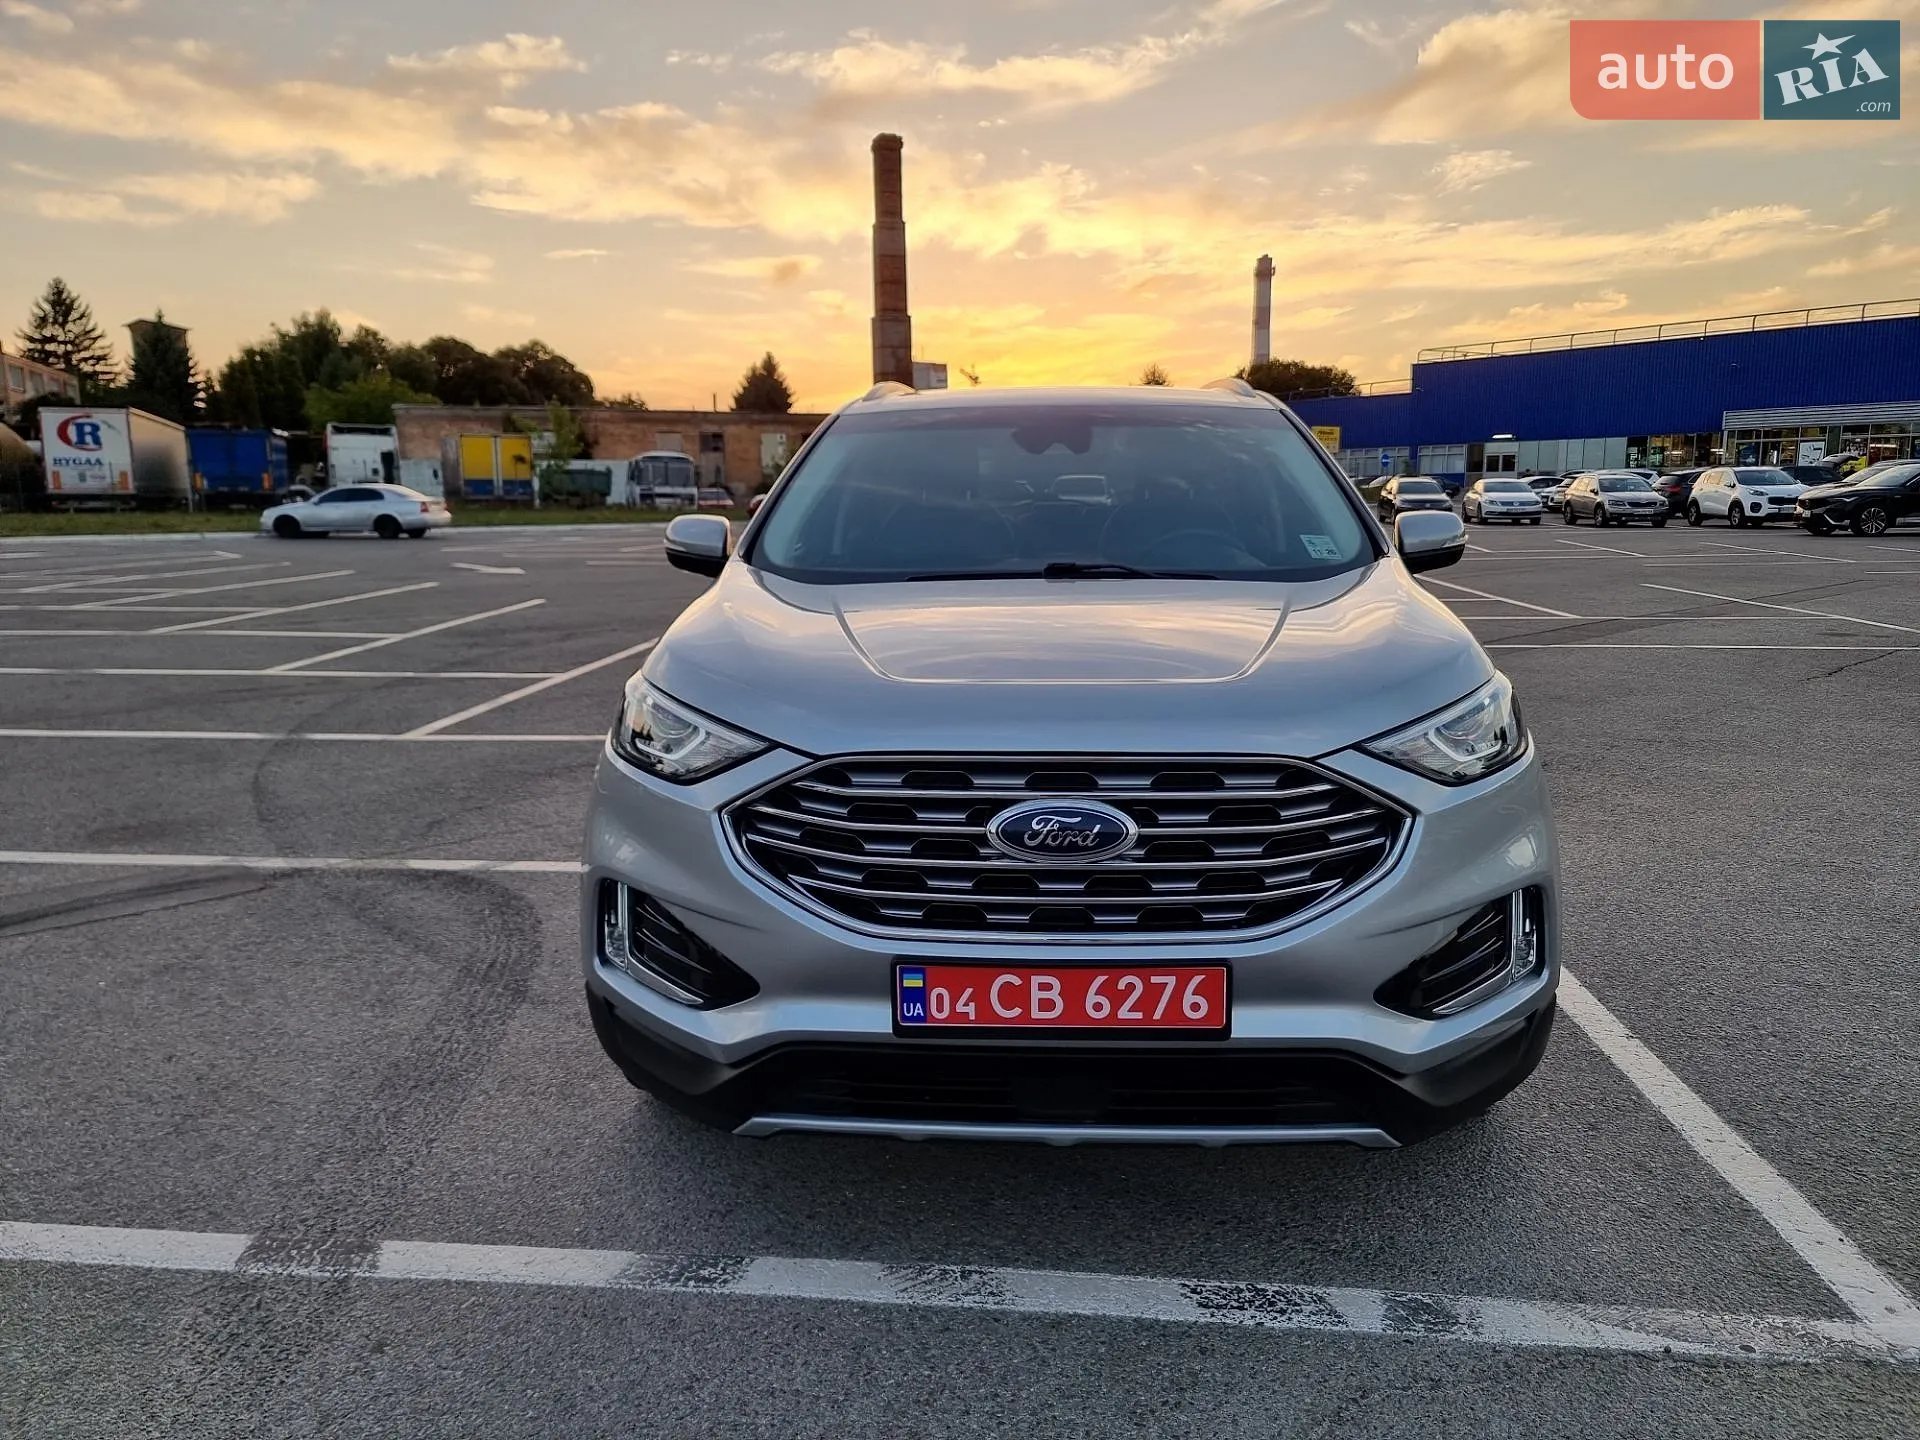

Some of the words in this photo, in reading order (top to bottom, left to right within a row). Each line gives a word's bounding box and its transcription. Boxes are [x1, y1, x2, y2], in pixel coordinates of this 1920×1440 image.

[1023, 815, 1102, 847] Ford
[903, 1003, 924, 1017] UA
[929, 987, 976, 1020] 04
[989, 974, 1064, 1019] CB
[1085, 975, 1209, 1020] 6276
